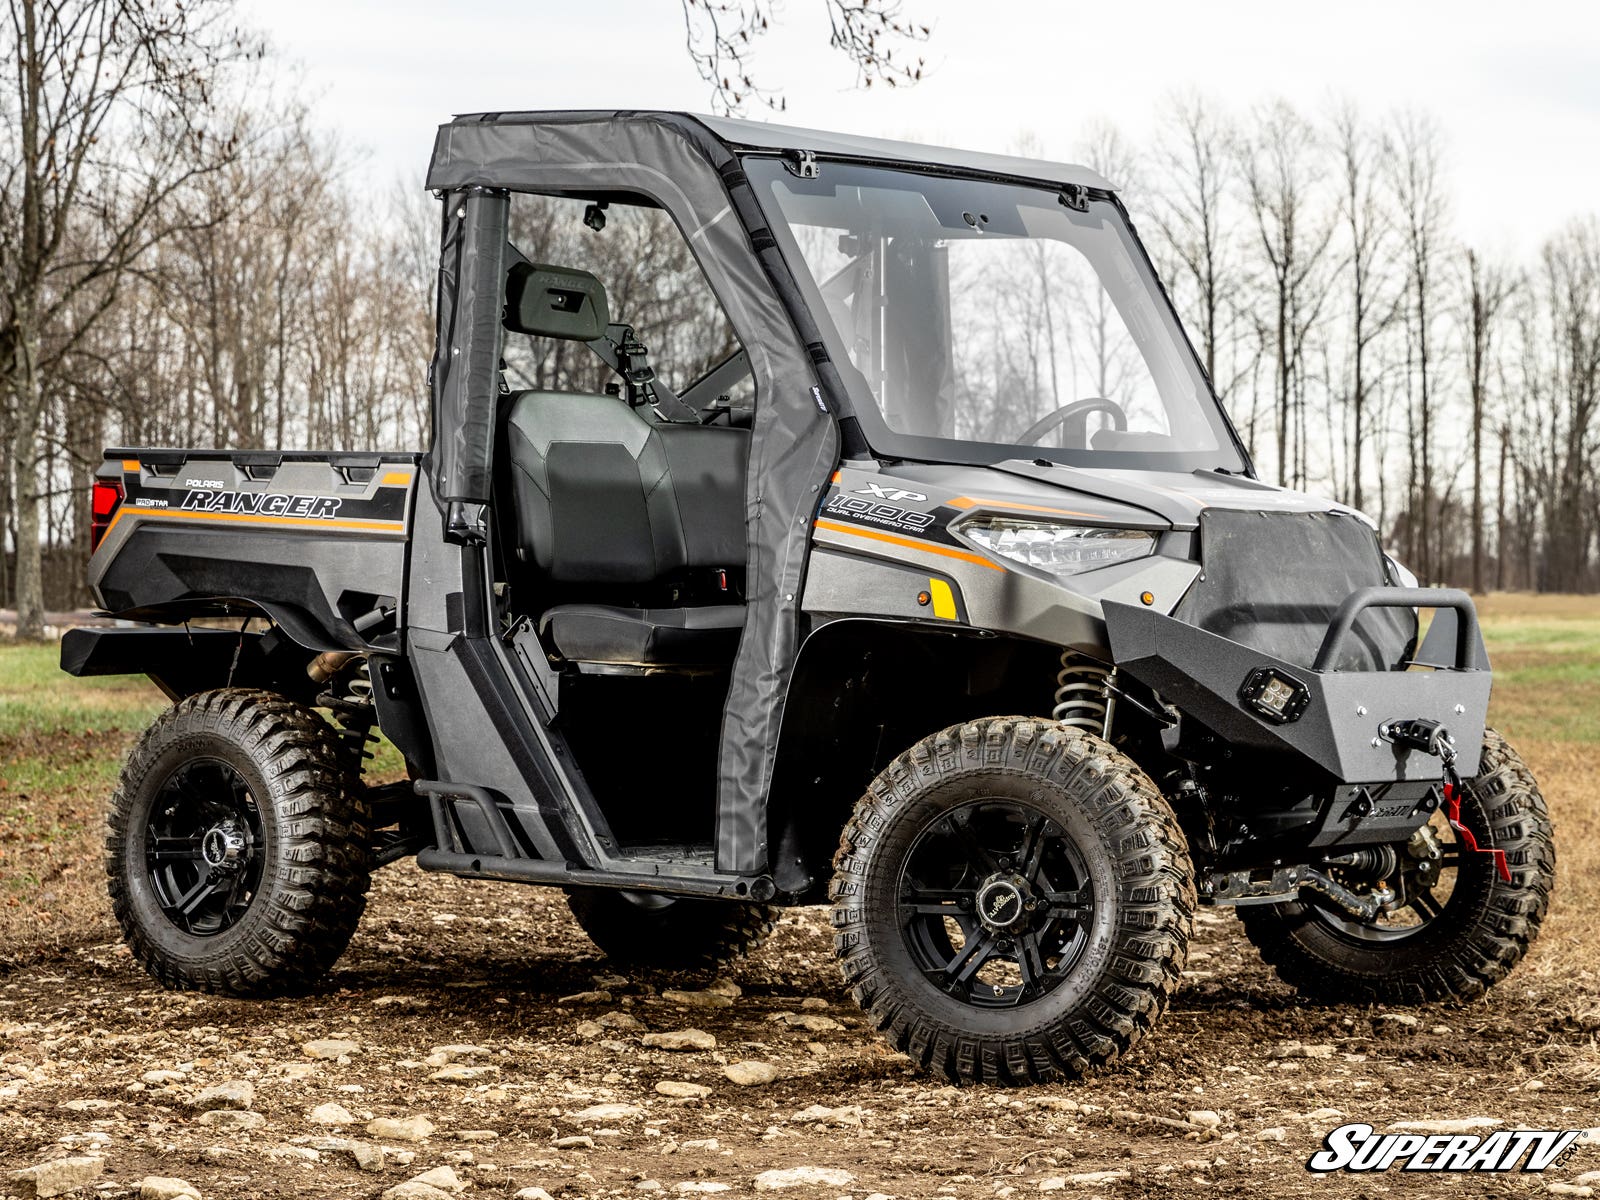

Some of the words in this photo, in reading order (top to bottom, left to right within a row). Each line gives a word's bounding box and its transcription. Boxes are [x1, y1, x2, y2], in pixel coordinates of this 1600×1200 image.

[185, 479, 225, 490] POLARIS
[849, 481, 929, 503] XP
[136, 497, 169, 508] PROSTAR
[181, 489, 342, 519] RANGER
[828, 494, 936, 528] 1000
[826, 506, 851, 516] DUAL
[852, 512, 903, 528] OVERHEAD
[902, 523, 925, 534] CAM
